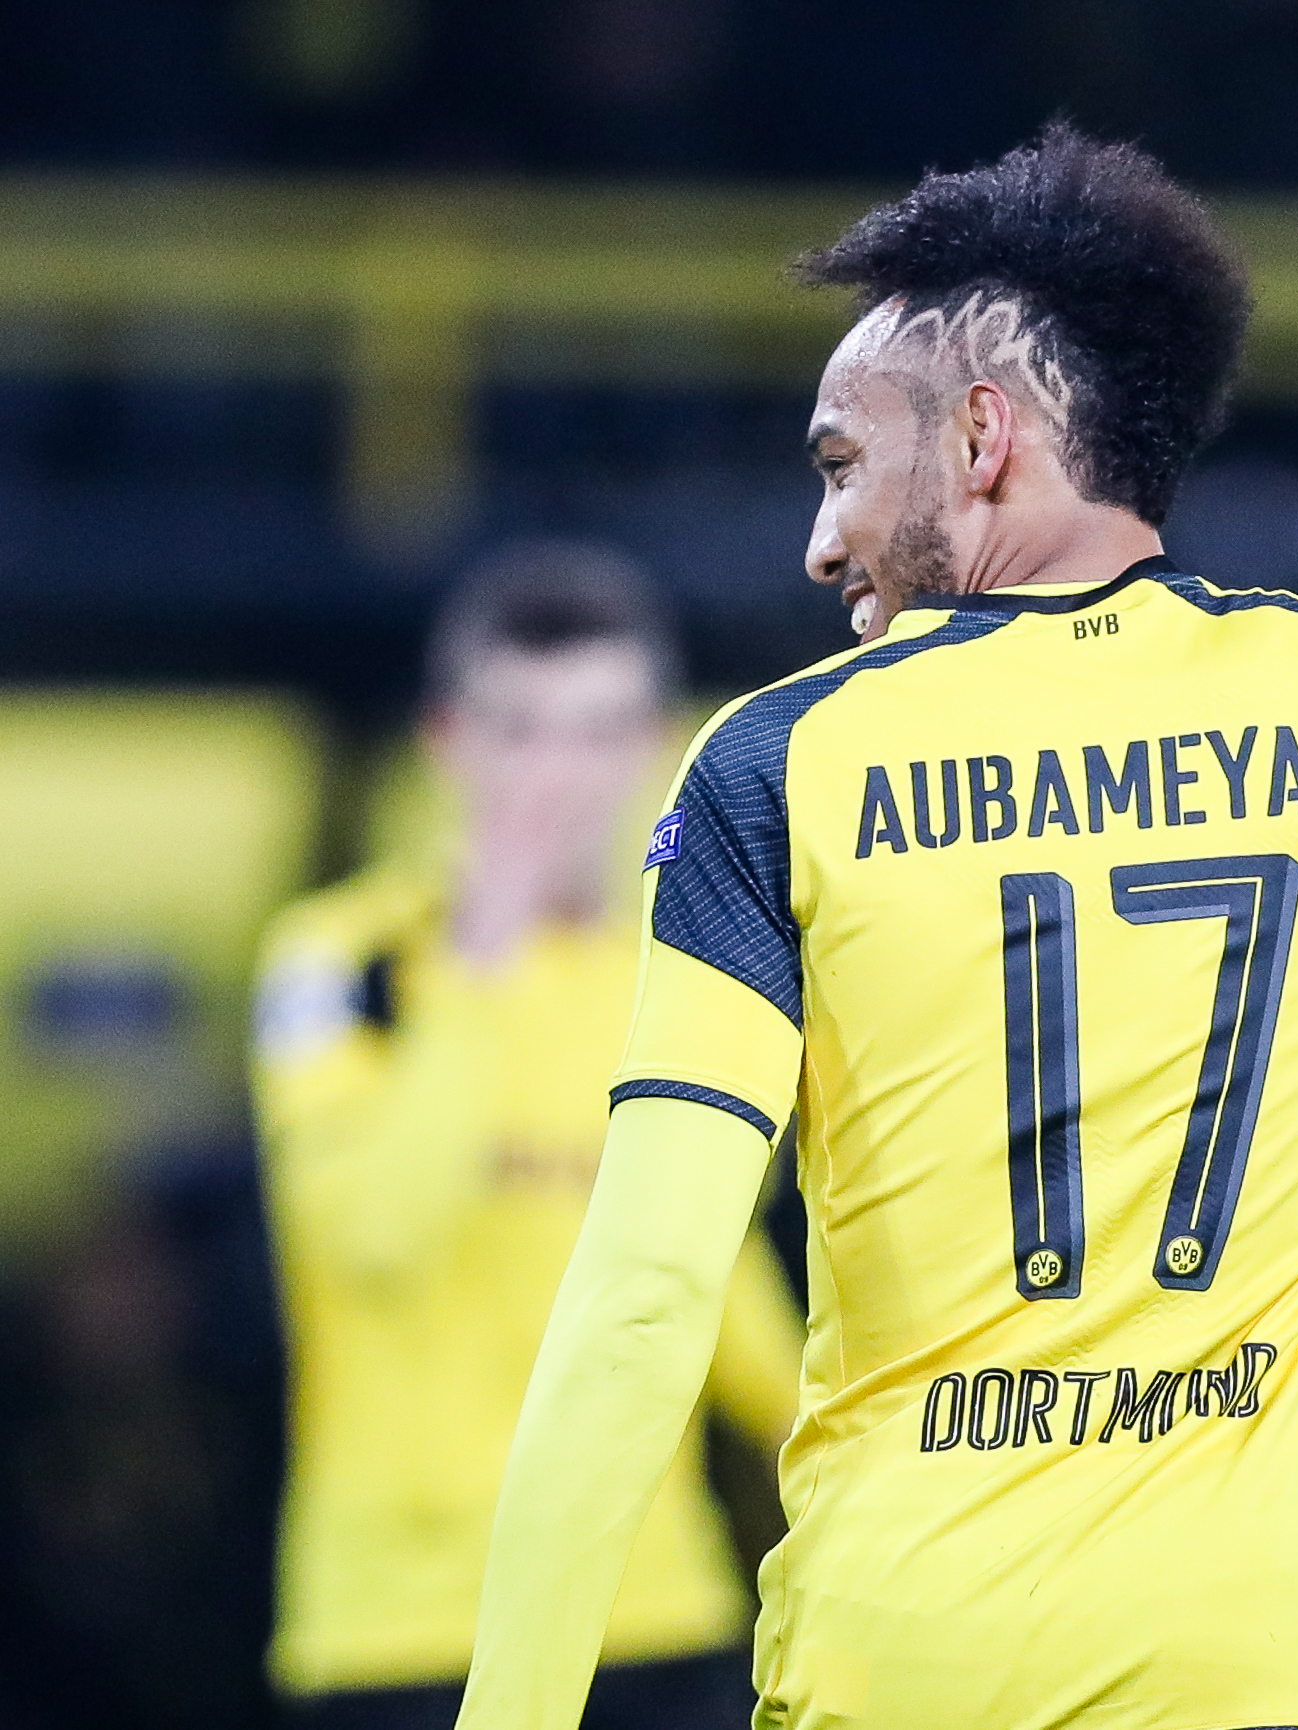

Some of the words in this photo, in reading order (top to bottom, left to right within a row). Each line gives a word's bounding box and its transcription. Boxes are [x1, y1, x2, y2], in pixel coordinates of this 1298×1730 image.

[1073, 613, 1119, 640] BVB
[1172, 1241, 1198, 1263] BVB
[1032, 1254, 1057, 1276] BVB
[920, 1342, 1278, 1452] DORTMUND
